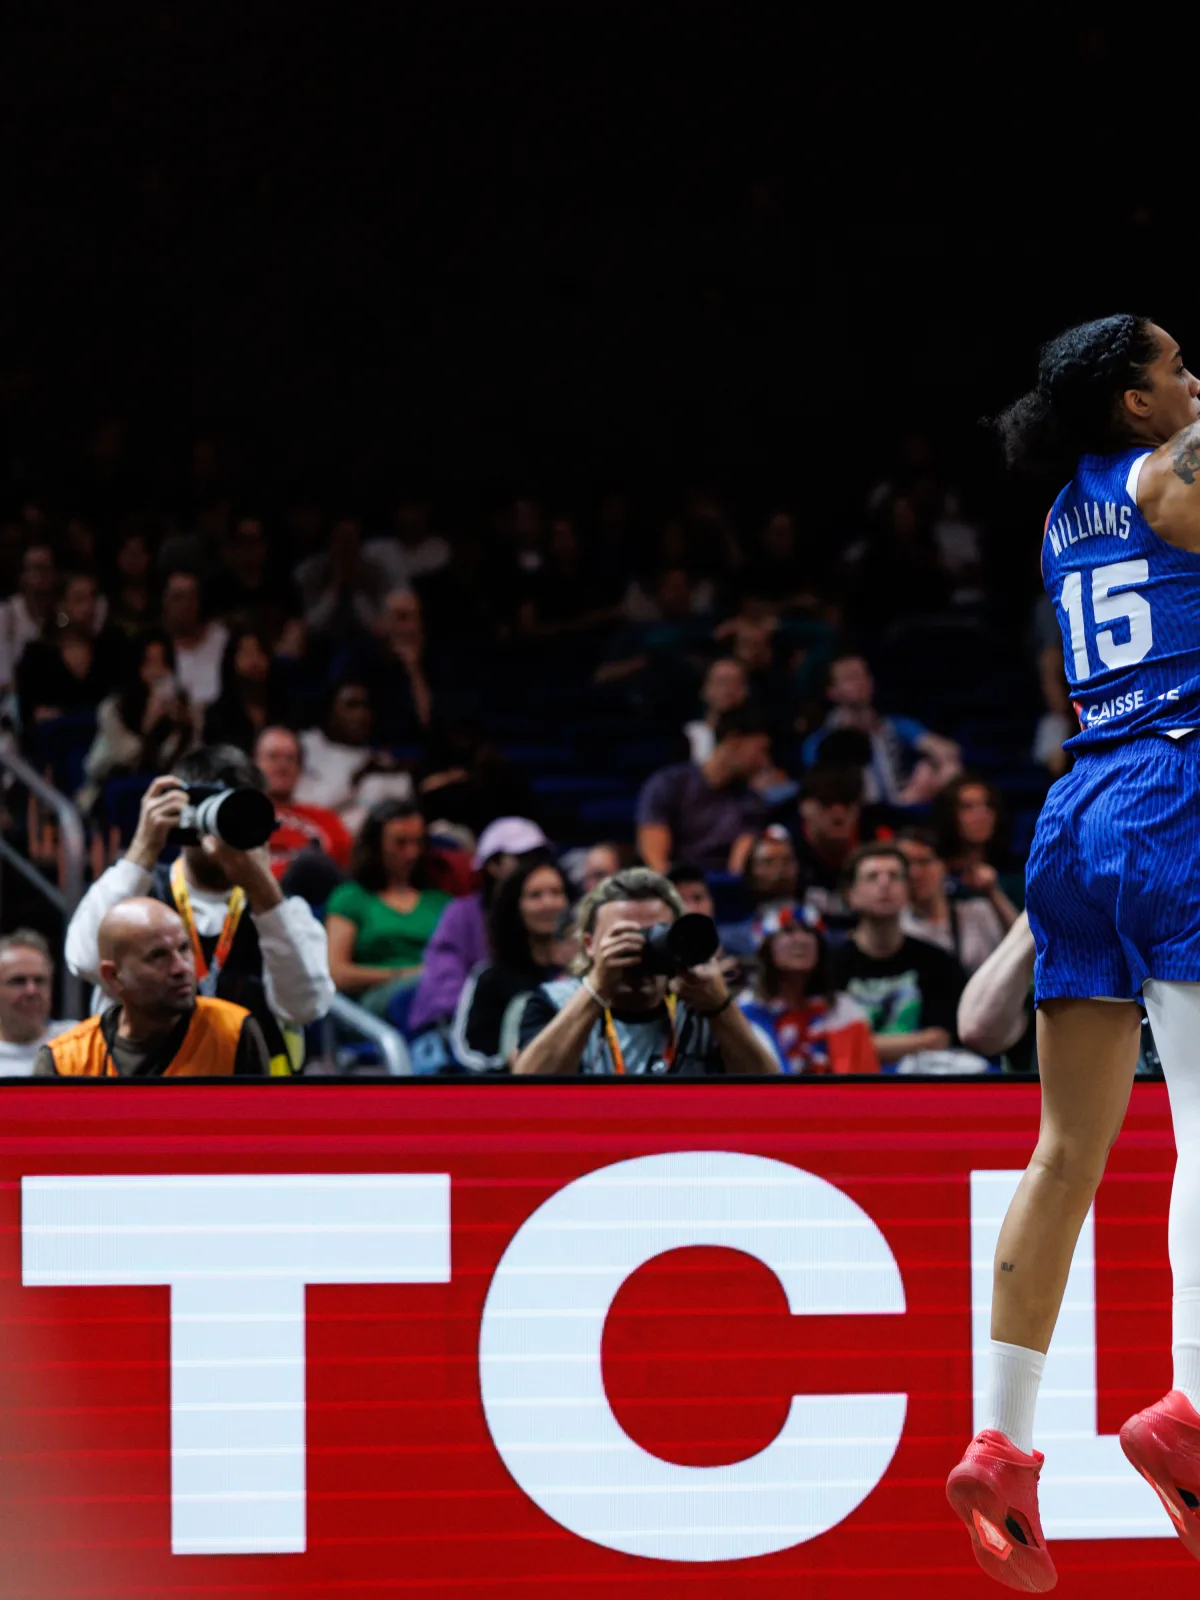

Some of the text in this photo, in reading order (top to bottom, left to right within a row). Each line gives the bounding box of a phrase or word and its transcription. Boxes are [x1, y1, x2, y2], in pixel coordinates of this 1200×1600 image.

[1048, 501, 1132, 557] WILLIAMS
[1061, 558, 1153, 681] 15
[1086, 690, 1145, 721] CAISSE
